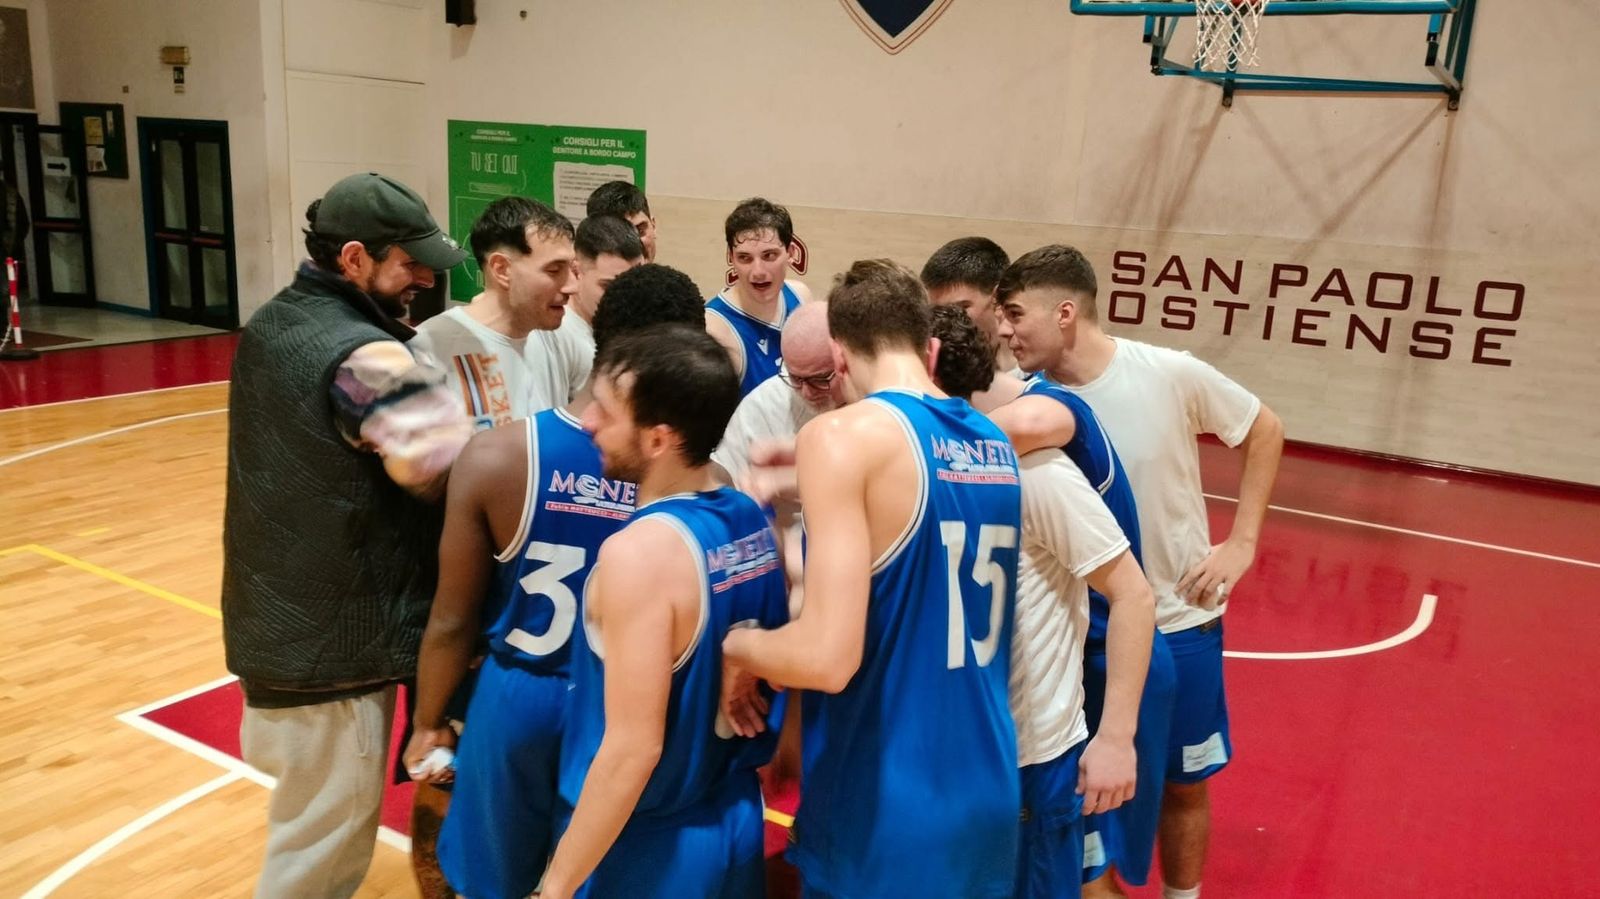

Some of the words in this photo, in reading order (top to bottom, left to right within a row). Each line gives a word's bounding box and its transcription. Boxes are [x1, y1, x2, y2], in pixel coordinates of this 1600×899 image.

[470, 151, 481, 171] TU
[563, 136, 599, 147] CONSIGLI
[600, 138, 616, 147] PER
[617, 140, 625, 149] IL
[612, 150, 637, 159] CAMPO
[1111, 250, 1243, 295] SAN
[1269, 263, 1525, 321] PAOLO
[1108, 290, 1517, 366] OSTIENSE
[504, 541, 587, 656] 3
[940, 520, 1017, 669] 15
